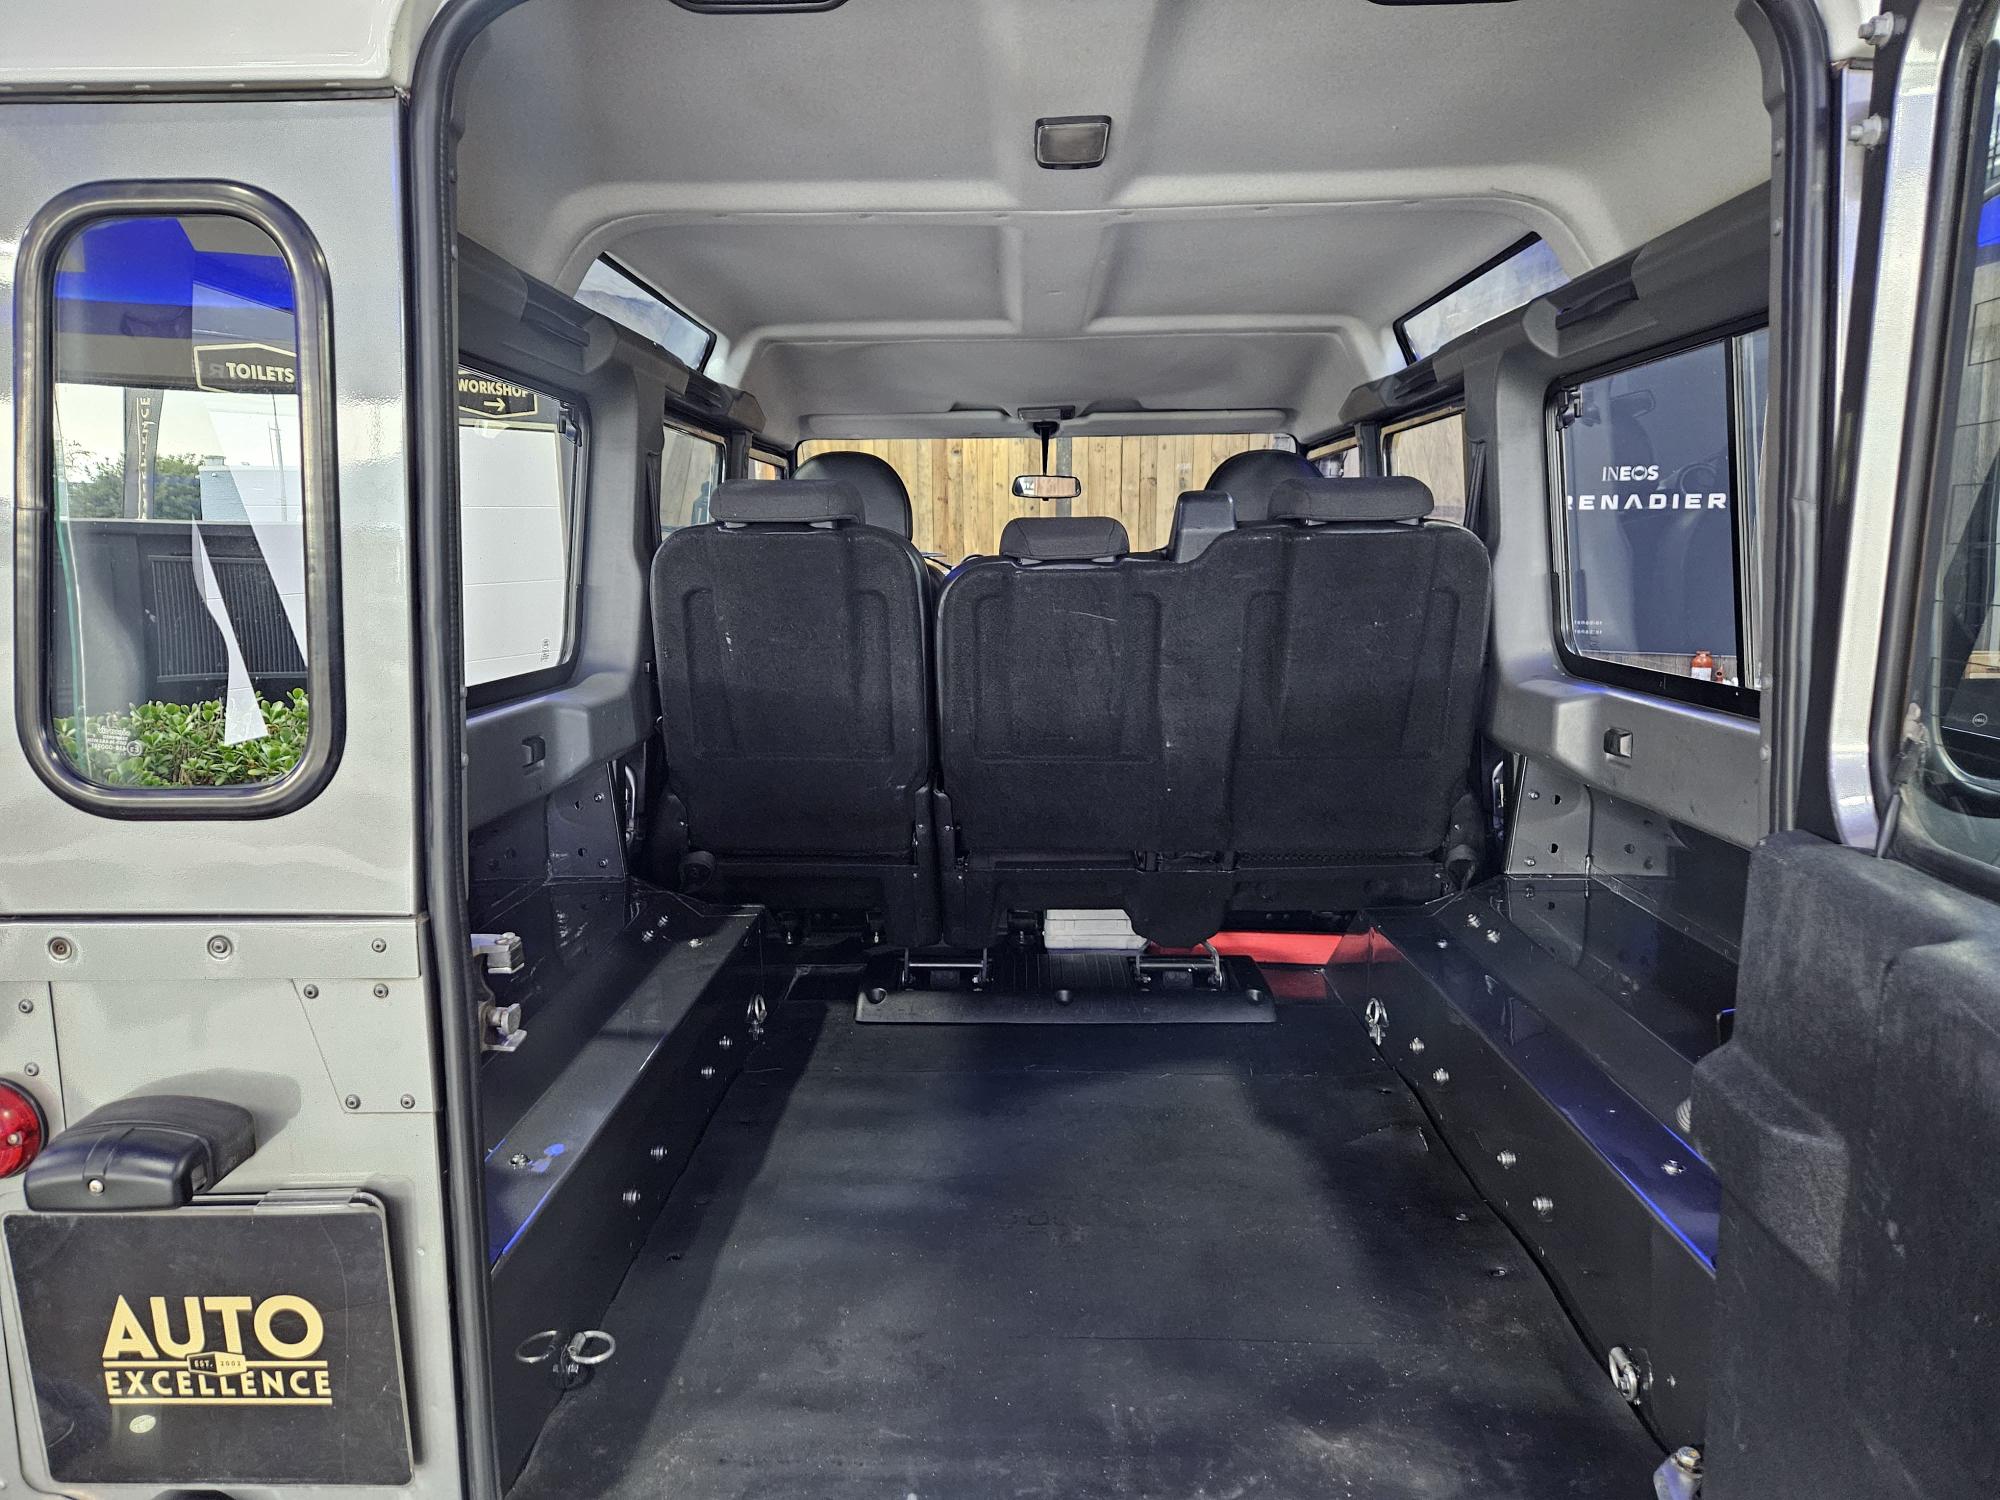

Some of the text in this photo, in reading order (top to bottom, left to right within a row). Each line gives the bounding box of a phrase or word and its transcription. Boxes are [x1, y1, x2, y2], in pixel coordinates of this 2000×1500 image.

[225, 362, 296, 383] TOILETS
[1602, 465, 1660, 481] INEOS
[102, 1294, 325, 1359] AUTO
[104, 1370, 332, 1396] EXCELLENCE
